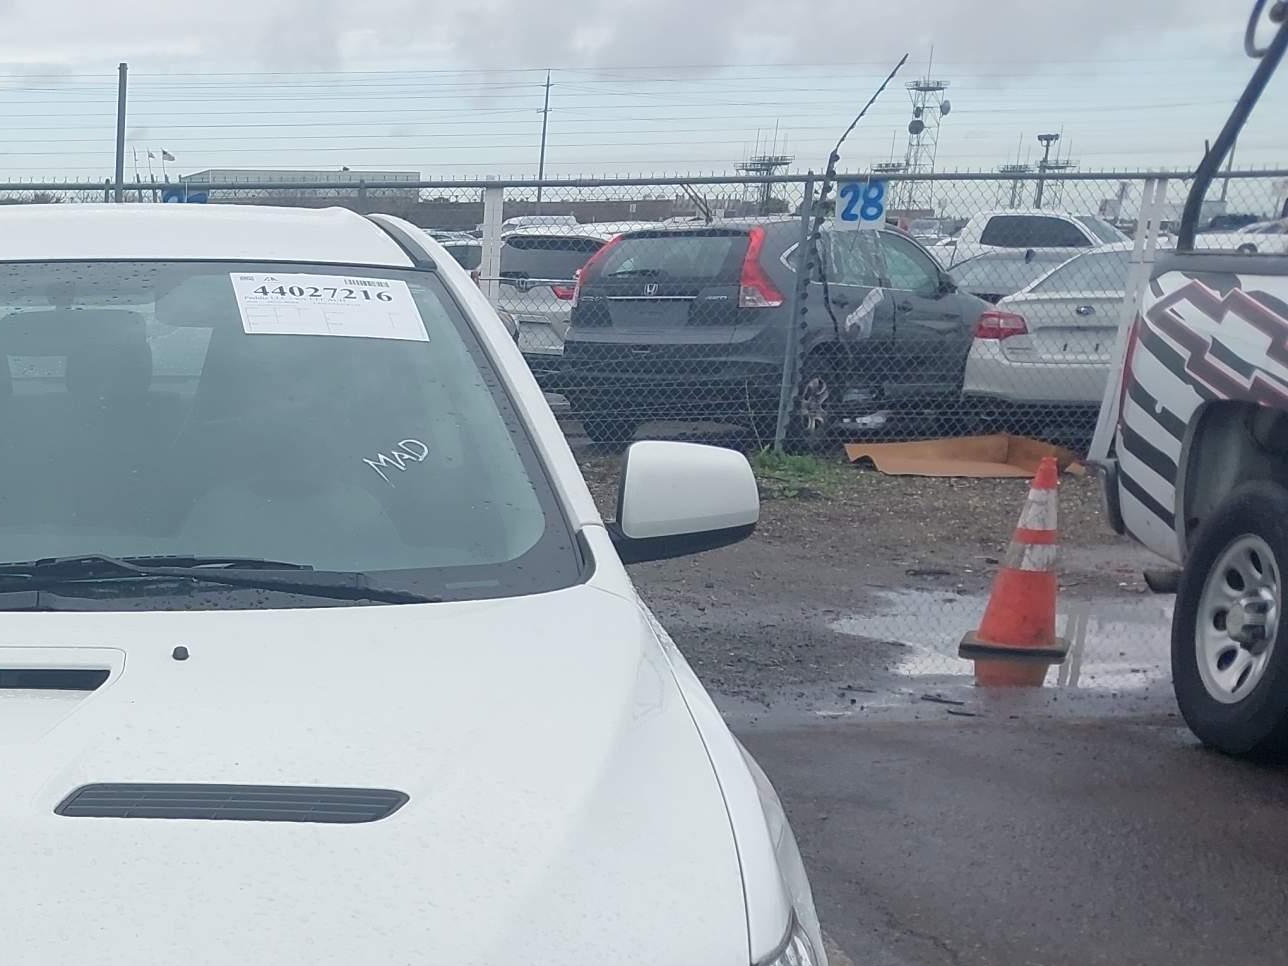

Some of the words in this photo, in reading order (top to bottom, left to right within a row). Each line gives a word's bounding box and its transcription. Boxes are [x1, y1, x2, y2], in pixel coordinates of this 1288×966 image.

[840, 181, 884, 221] 28
[253, 284, 394, 303] 44027216
[362, 439, 429, 482] MAD
